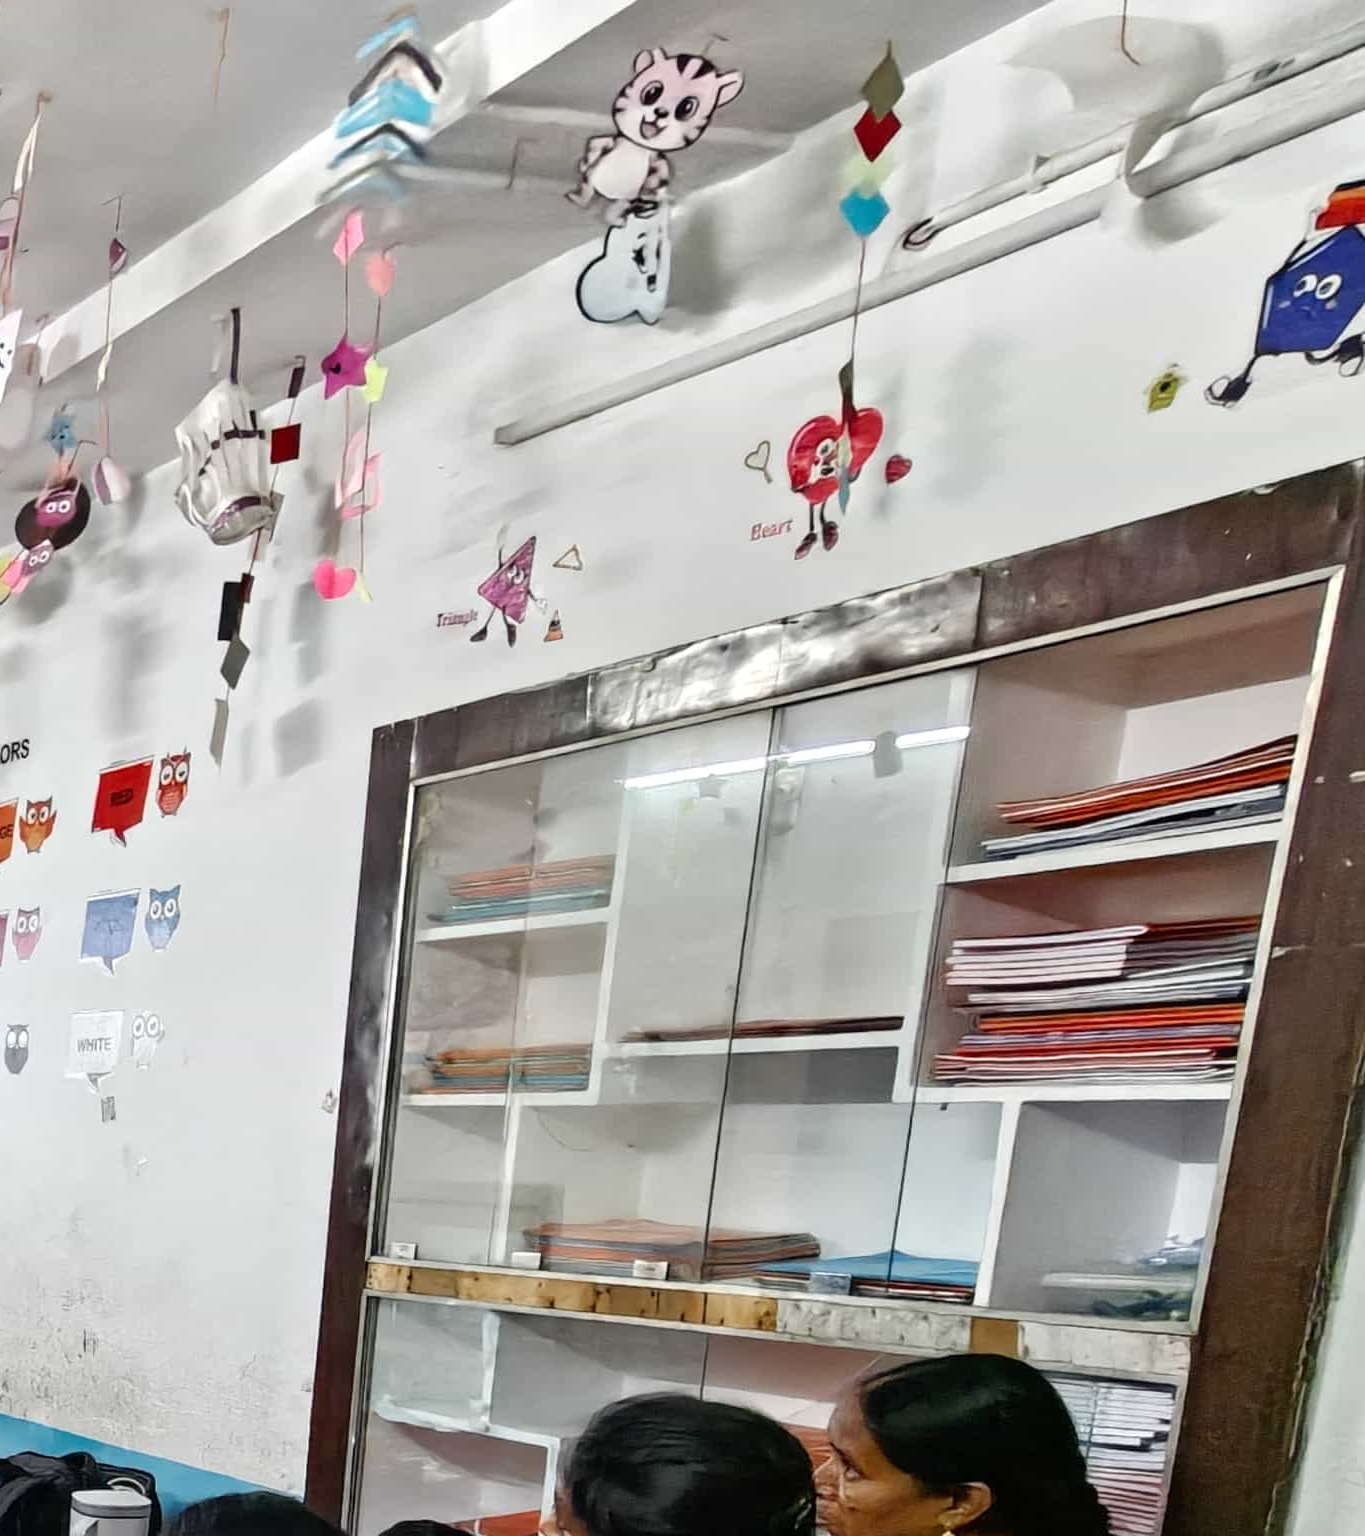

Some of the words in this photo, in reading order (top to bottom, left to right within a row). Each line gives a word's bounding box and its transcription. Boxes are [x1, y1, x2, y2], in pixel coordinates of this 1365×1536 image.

[749, 519, 794, 542] Heart
[109, 788, 134, 807] RED
[76, 1037, 112, 1054] WHITE
